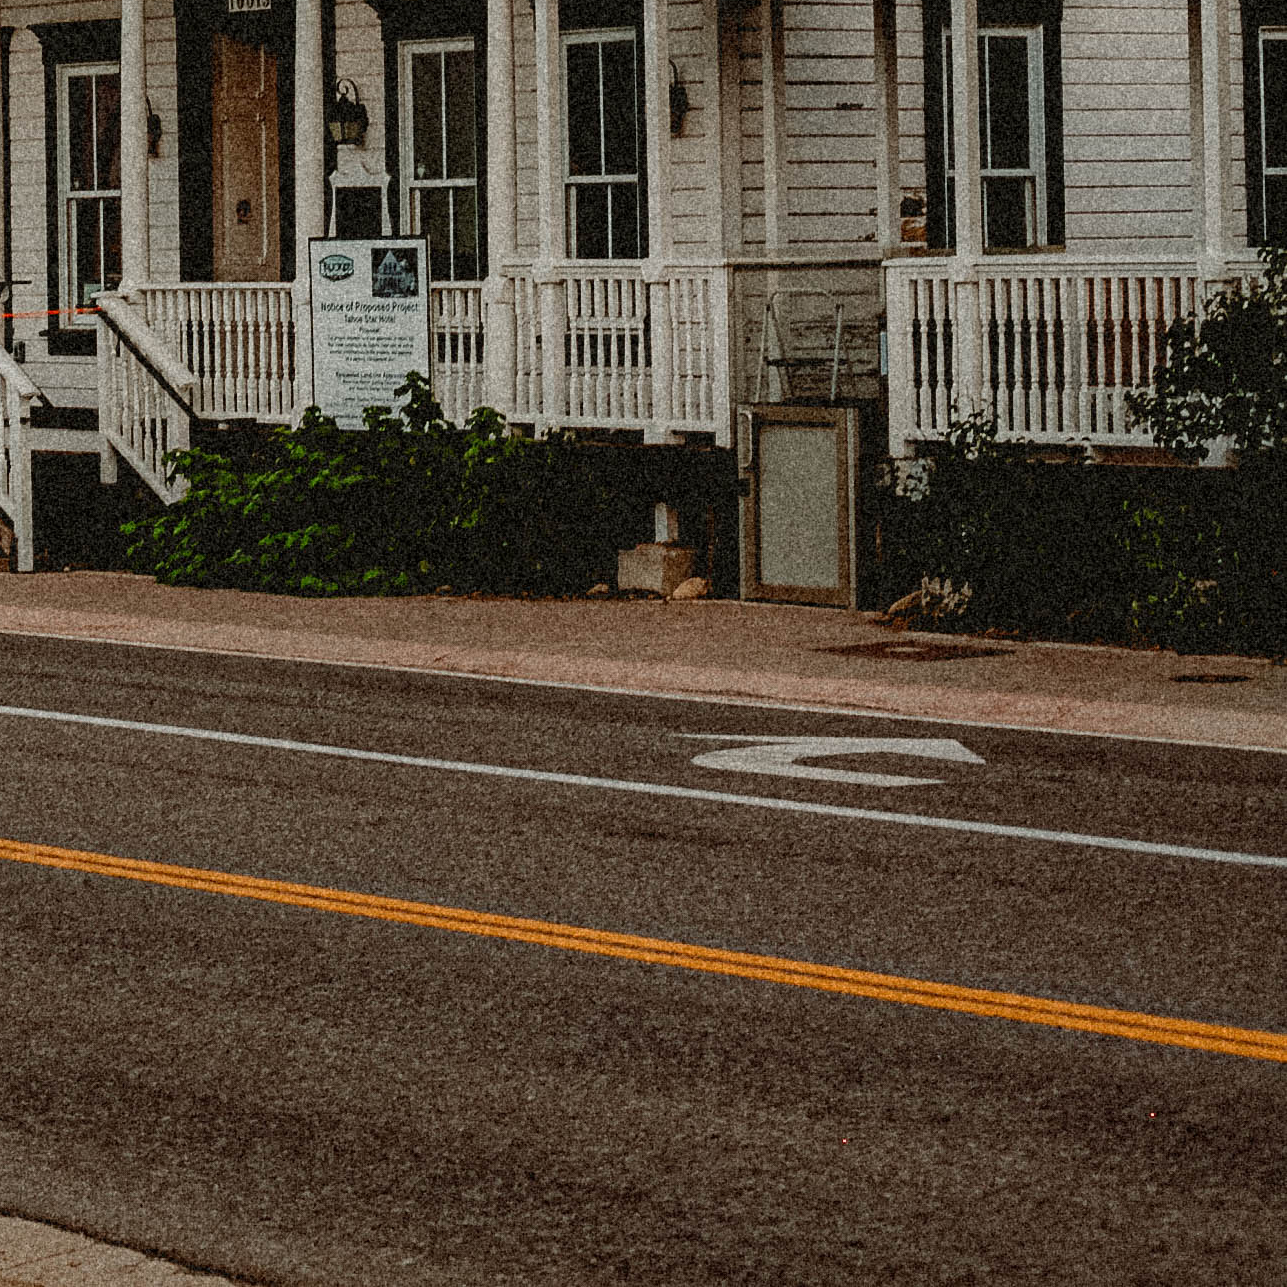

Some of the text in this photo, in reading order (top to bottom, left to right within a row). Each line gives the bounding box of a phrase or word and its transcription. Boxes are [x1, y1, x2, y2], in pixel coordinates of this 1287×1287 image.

[320, 301, 419, 315] Notice of Proposed Project
